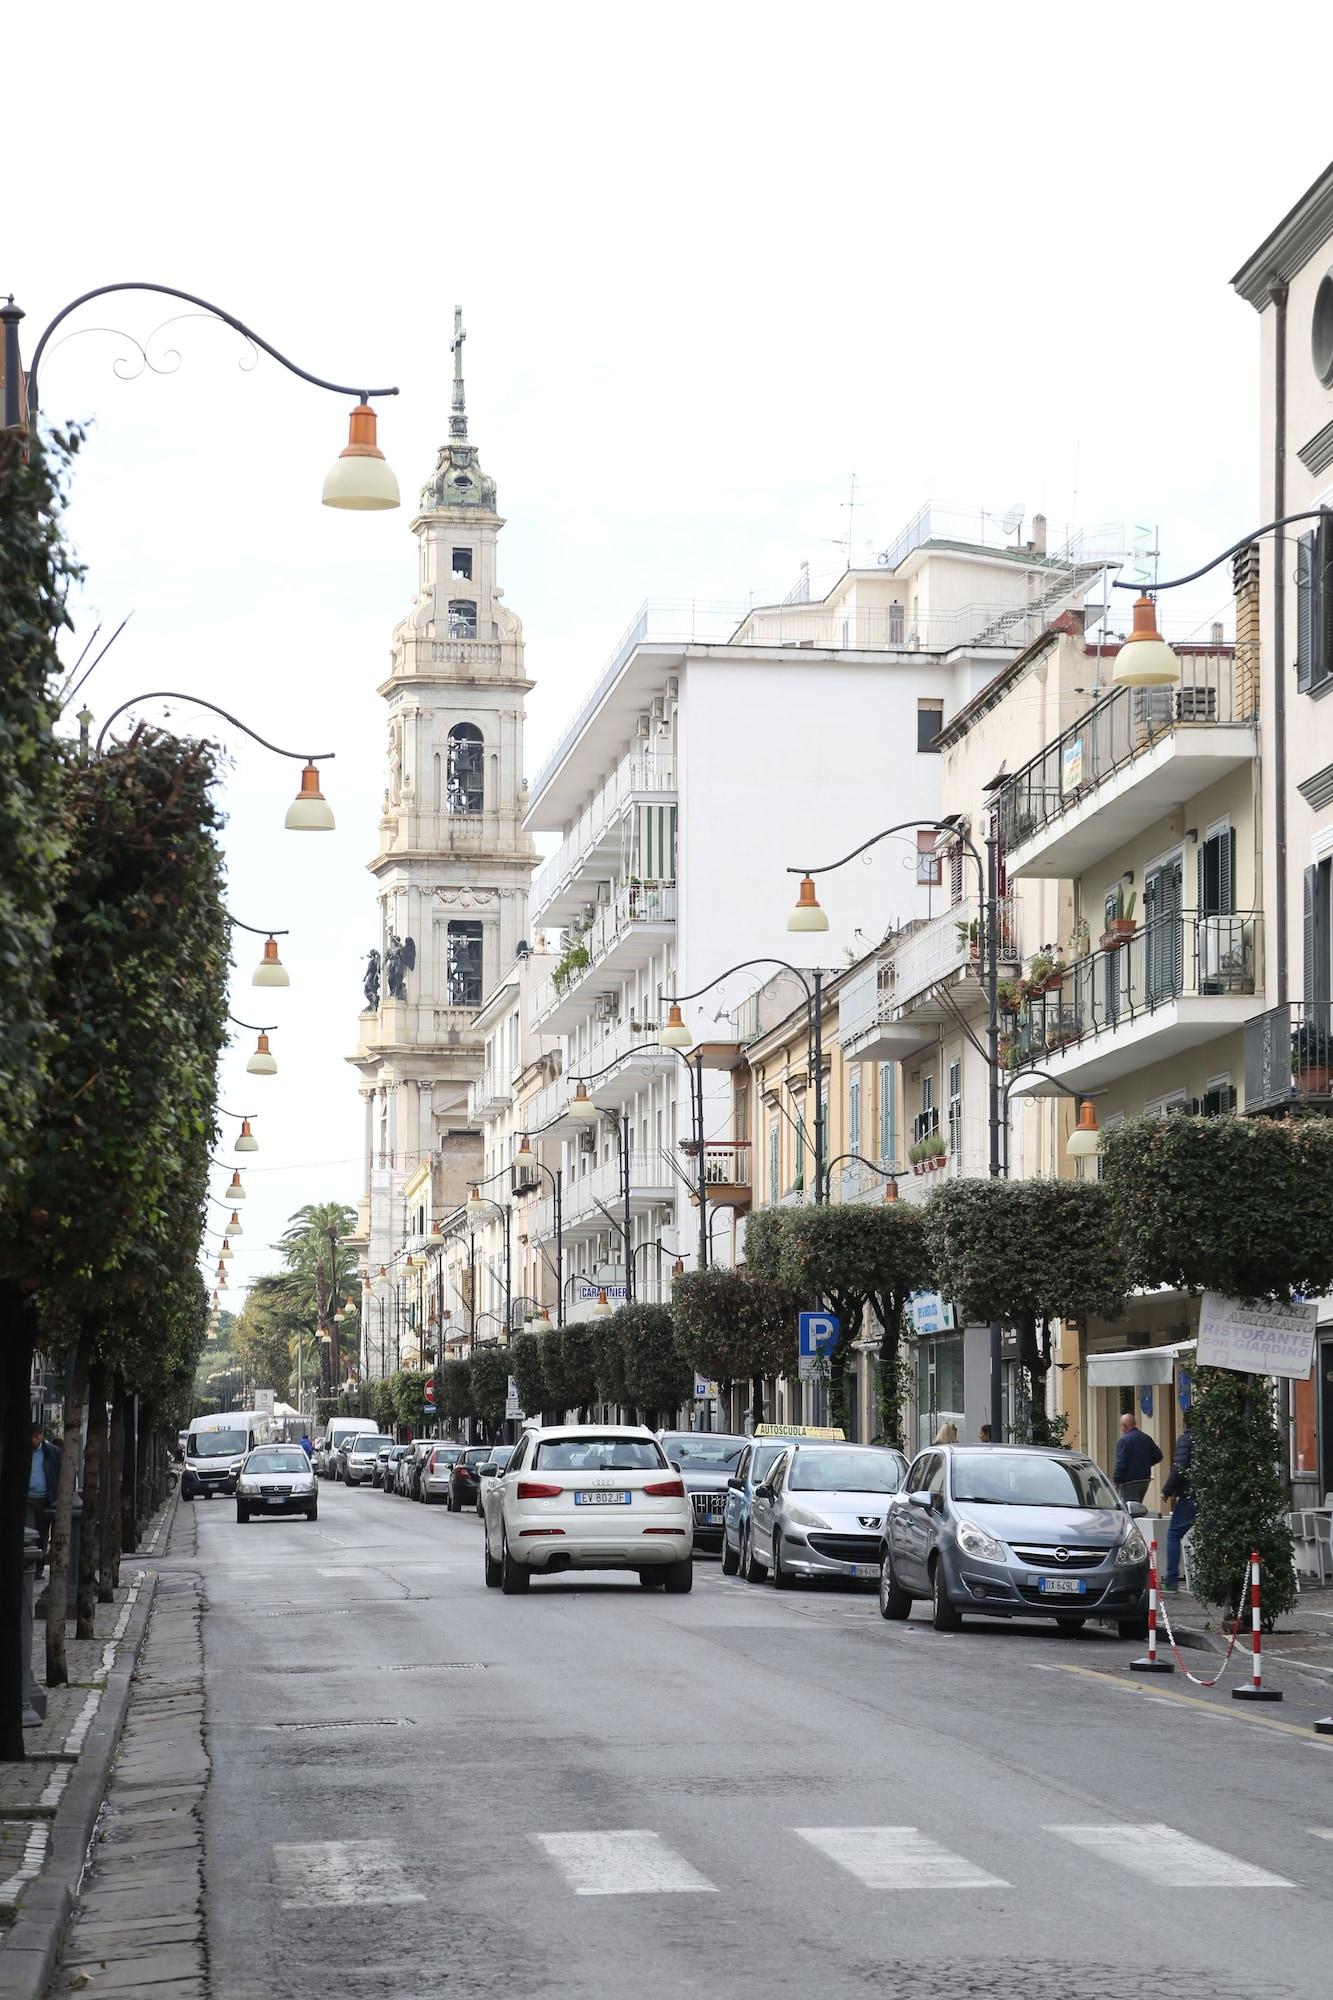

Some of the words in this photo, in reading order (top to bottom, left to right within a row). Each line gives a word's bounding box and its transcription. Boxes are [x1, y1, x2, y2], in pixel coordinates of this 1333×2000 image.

[582, 1287, 627, 1297] CARAINIER
[1237, 1299, 1310, 1319] HOTEL
[809, 1319, 833, 1351] P
[1203, 1323, 1313, 1347] RISTORANTE
[1203, 1338, 1228, 1347] con
[1234, 1341, 1308, 1358] GIARDINO
[760, 1425, 807, 1436] AUTOSCUOLA
[583, 1493, 593, 1502] EV
[596, 1492, 624, 1502] 802JF
